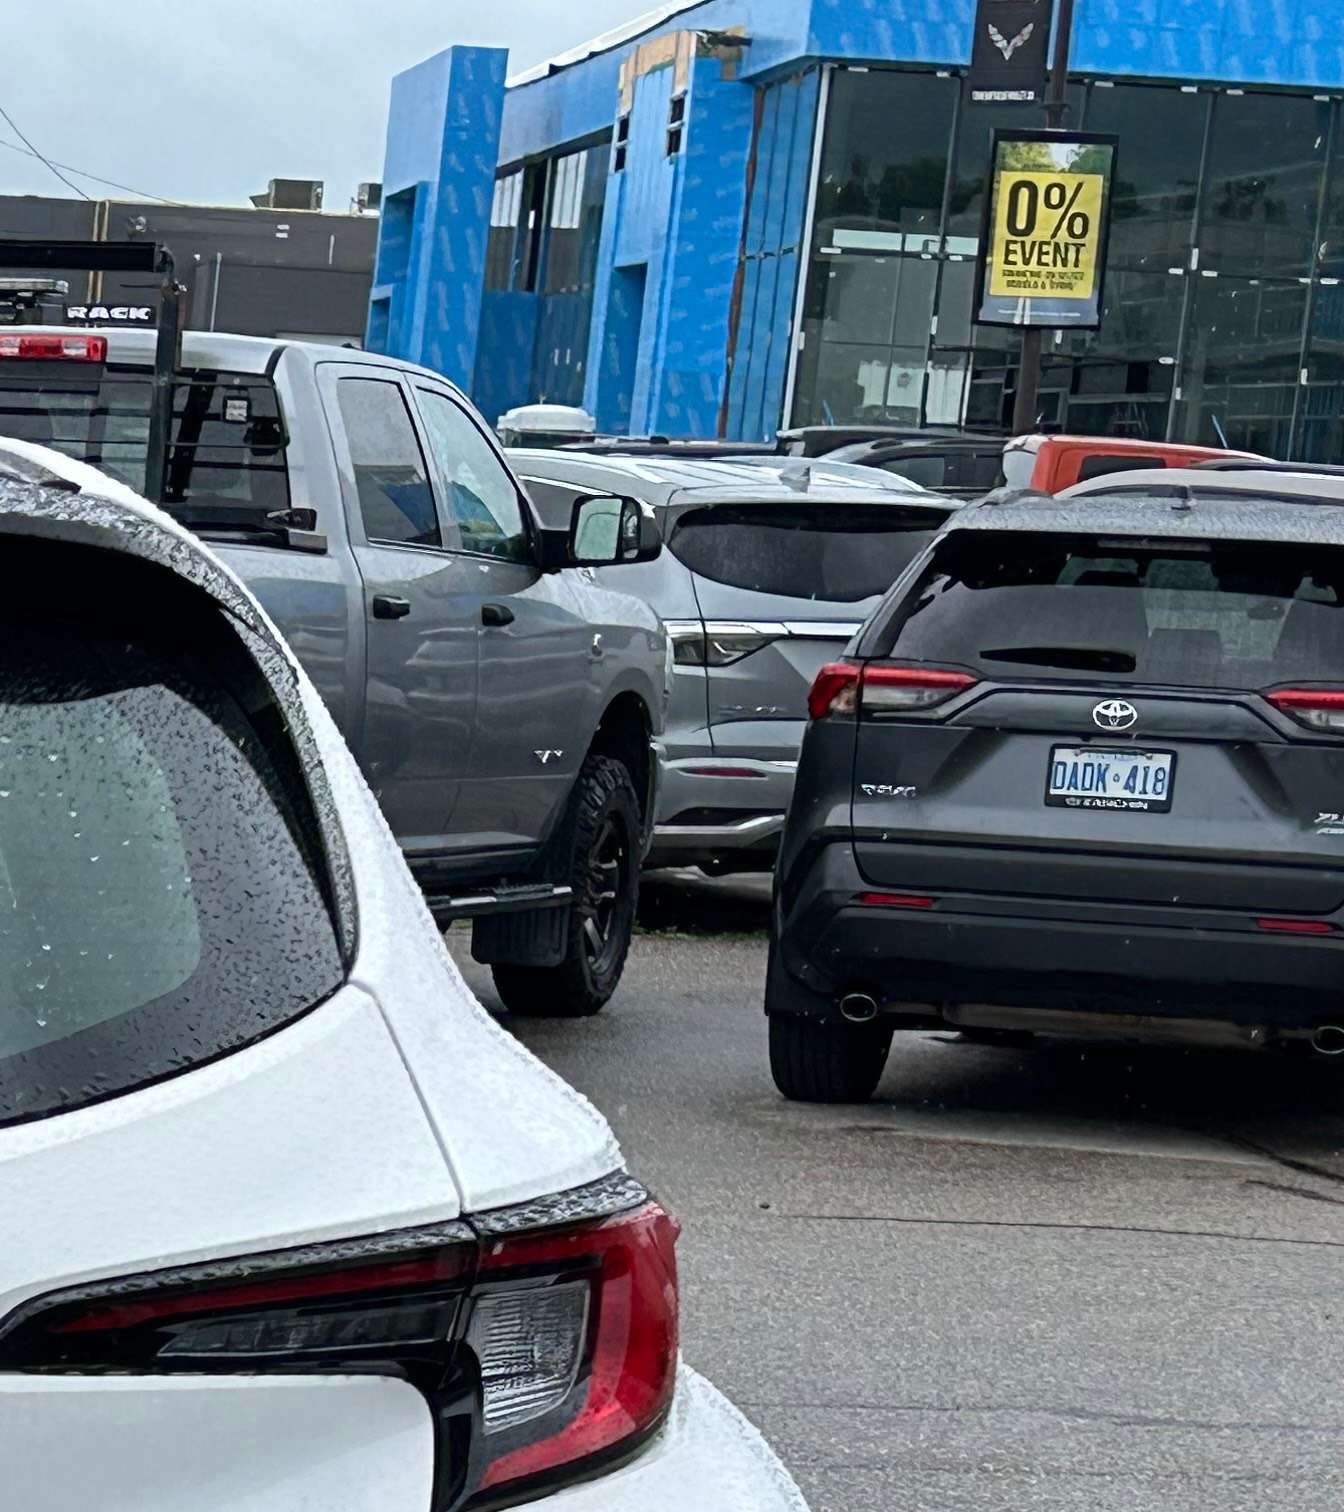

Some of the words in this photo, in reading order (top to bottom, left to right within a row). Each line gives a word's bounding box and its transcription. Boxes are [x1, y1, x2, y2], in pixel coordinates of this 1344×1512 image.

[1006, 179, 1090, 240] 0%
[1003, 239, 1086, 268] EVENT
[67, 306, 152, 320] RACK
[1052, 760, 1111, 793] DADK
[1123, 765, 1167, 796] 418
